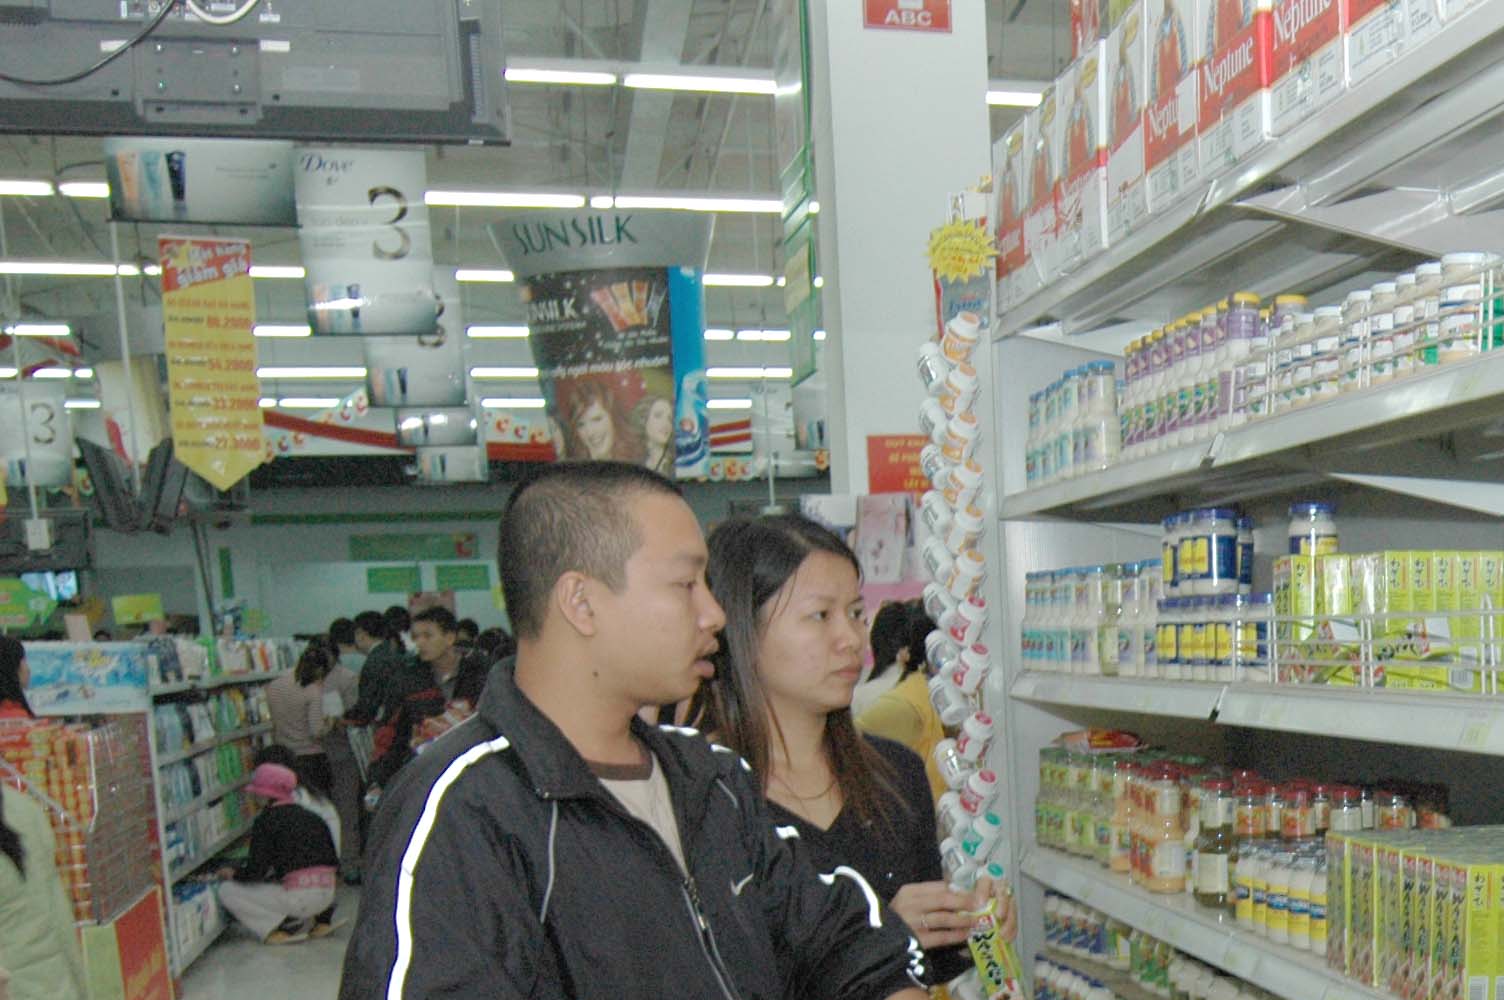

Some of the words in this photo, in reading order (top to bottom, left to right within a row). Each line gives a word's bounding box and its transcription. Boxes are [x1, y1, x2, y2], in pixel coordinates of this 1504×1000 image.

[885, 9, 932, 25] ABC
[1203, 37, 1253, 101] Neptune
[301, 153, 353, 172] Dove
[368, 186, 410, 260] 3
[513, 215, 638, 256] SUNSILK
